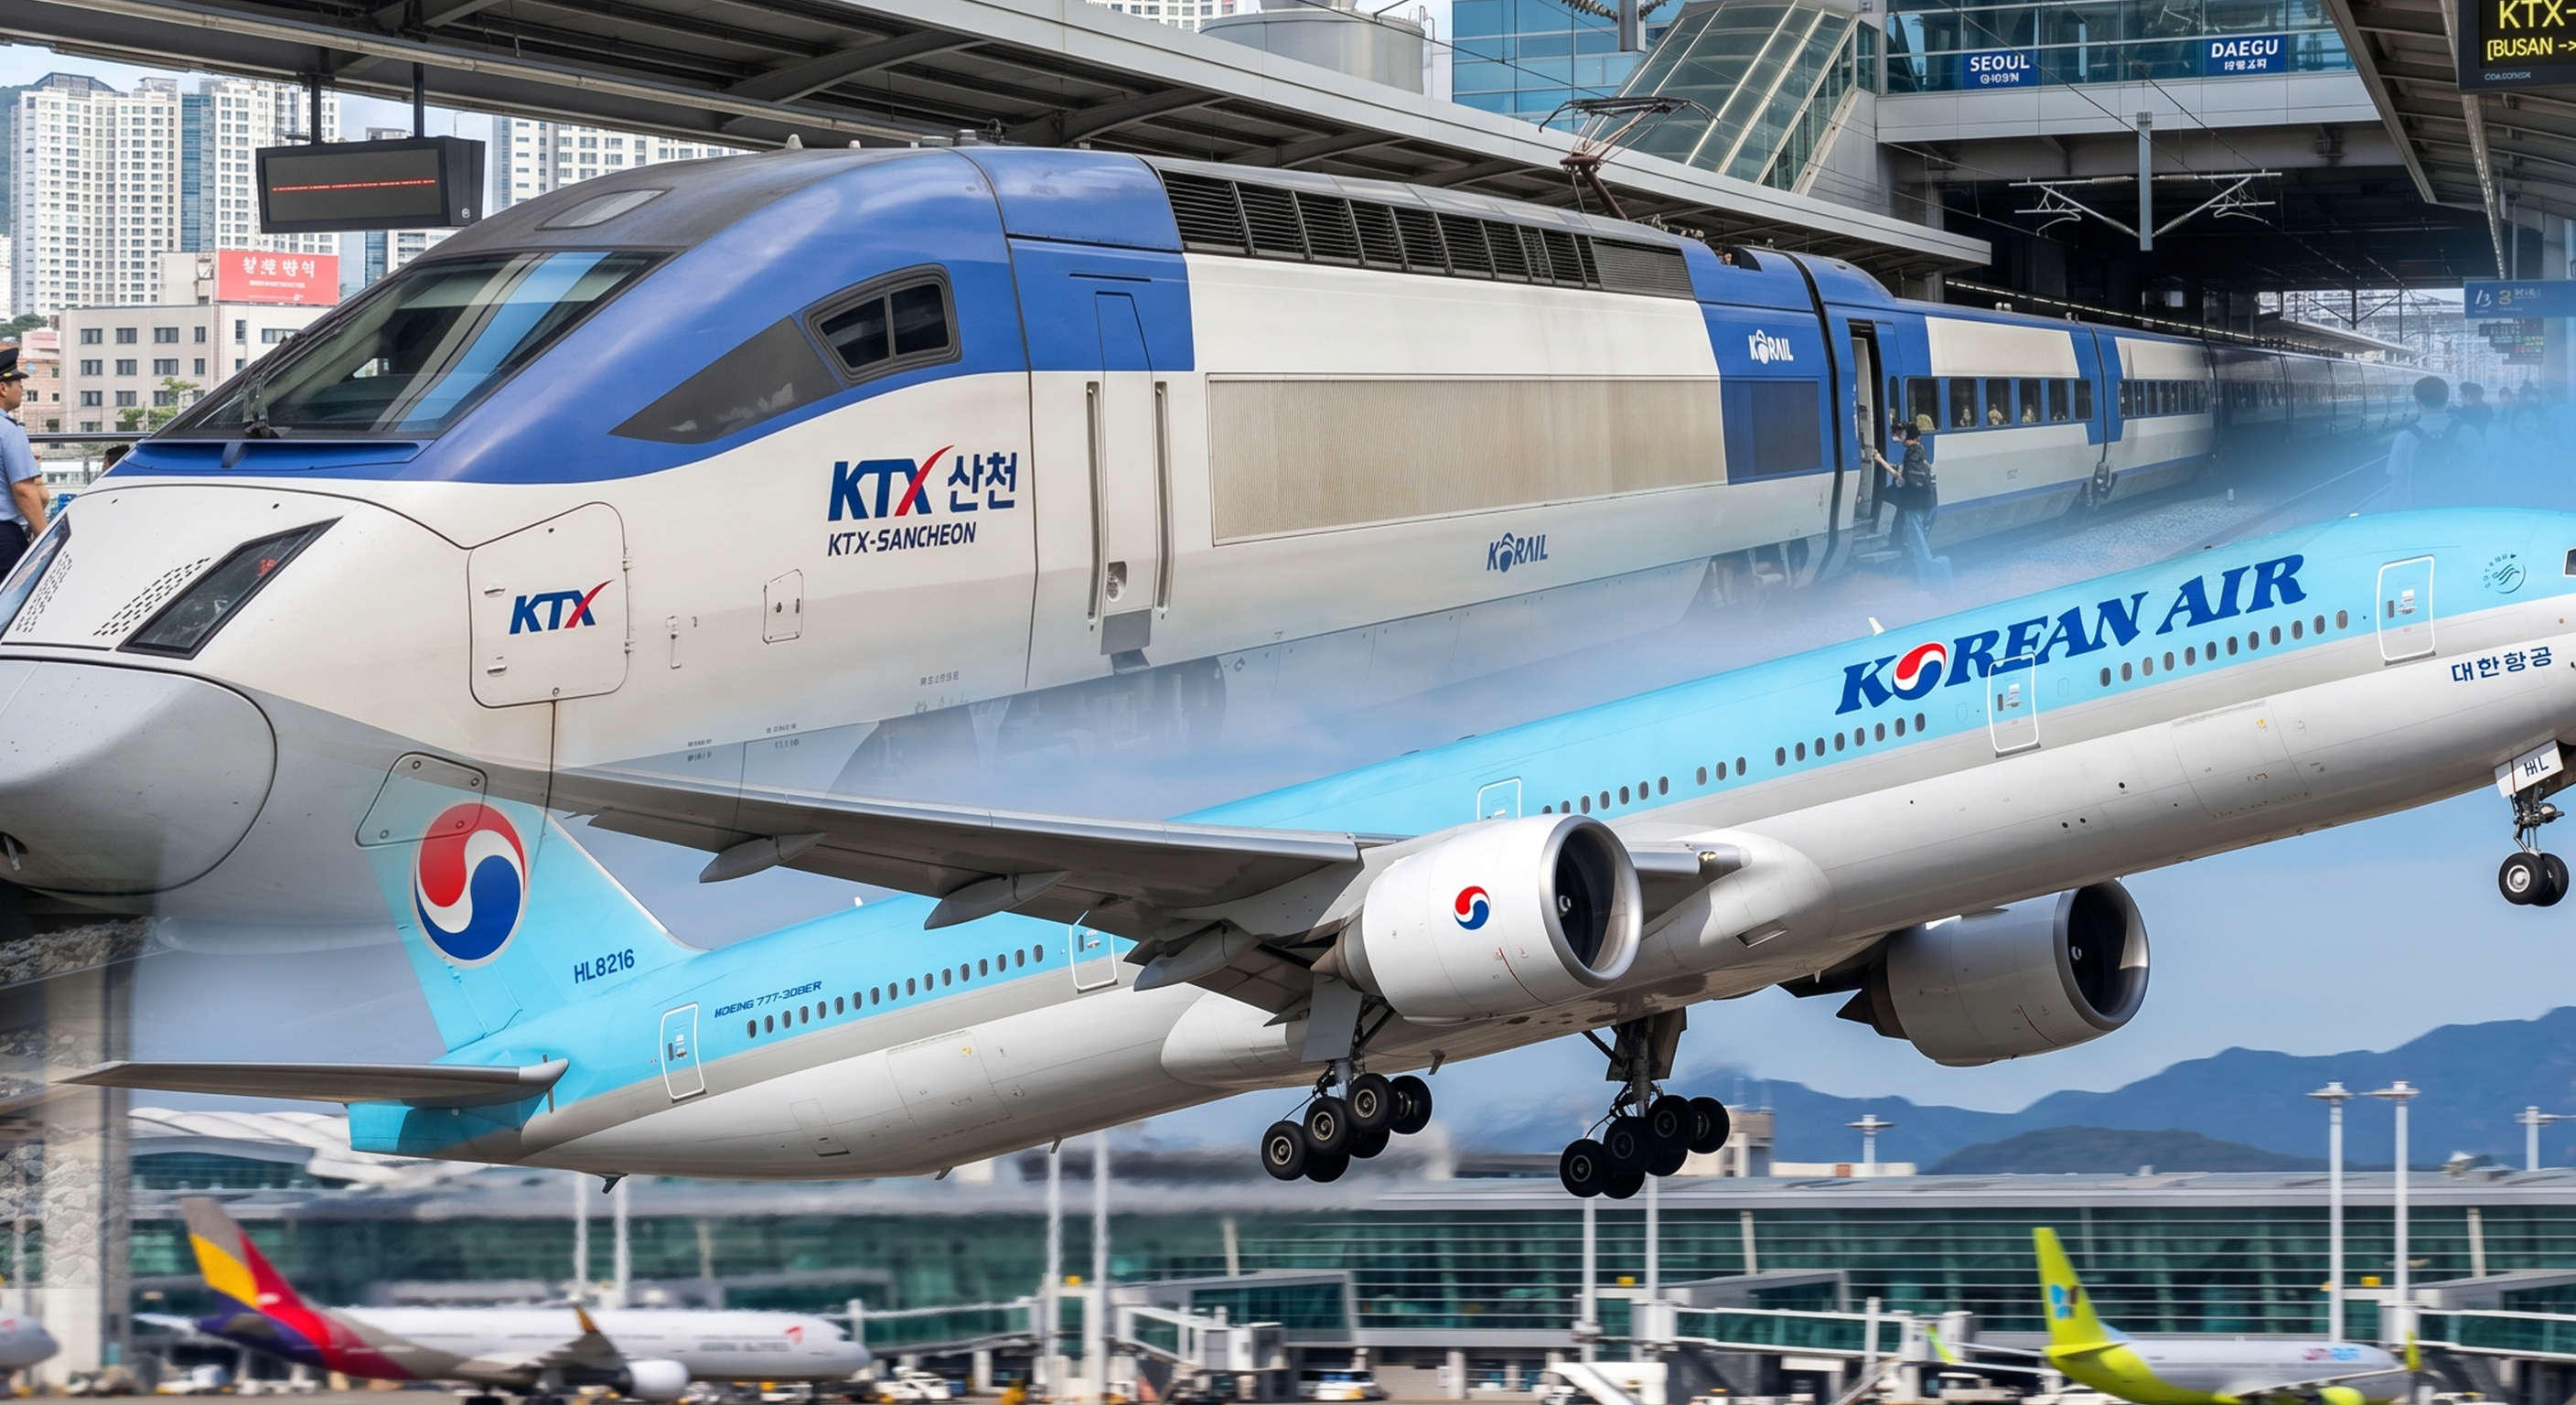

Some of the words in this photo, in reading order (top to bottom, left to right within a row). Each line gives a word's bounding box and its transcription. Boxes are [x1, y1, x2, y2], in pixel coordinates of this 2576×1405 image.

[1970, 55, 2030, 72] SEOUL
[2211, 38, 2279, 59] DAEGU
[1748, 328, 1794, 365] KORAIL
[827, 445, 955, 521] KTX
[948, 452, 1017, 513] 산천
[827, 521, 977, 557] KTX-SANCHEON
[1487, 531, 1549, 574] KORAIL
[509, 578, 617, 635] KTX
[1834, 591, 2149, 715] KOREAN
[2155, 553, 2307, 636] AIR
[2451, 646, 2552, 682] 대한항공
[574, 949, 635, 984] HL8216
